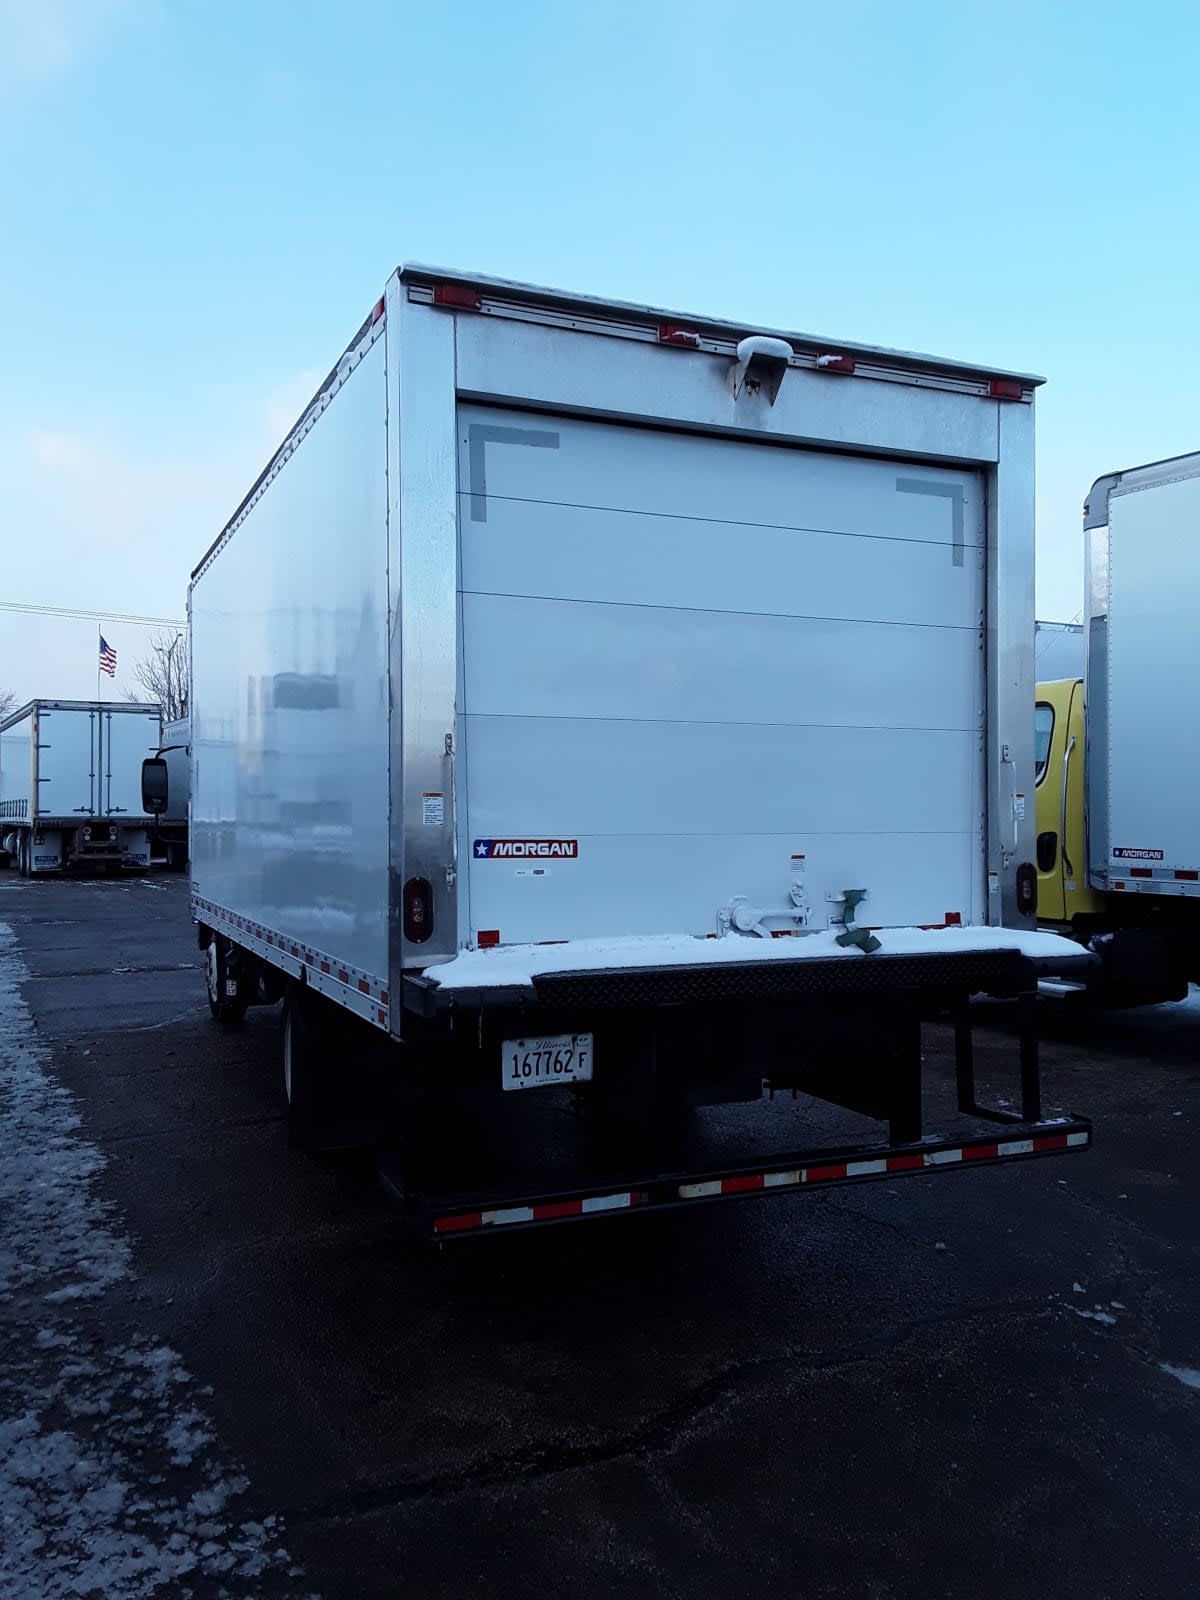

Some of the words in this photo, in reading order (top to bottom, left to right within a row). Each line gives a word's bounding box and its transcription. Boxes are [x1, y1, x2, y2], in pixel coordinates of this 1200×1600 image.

[492, 843, 574, 856] MORGAN
[1121, 849, 1162, 859] MORGAN
[511, 1049, 574, 1079] 167762
[578, 1052, 588, 1069] F
